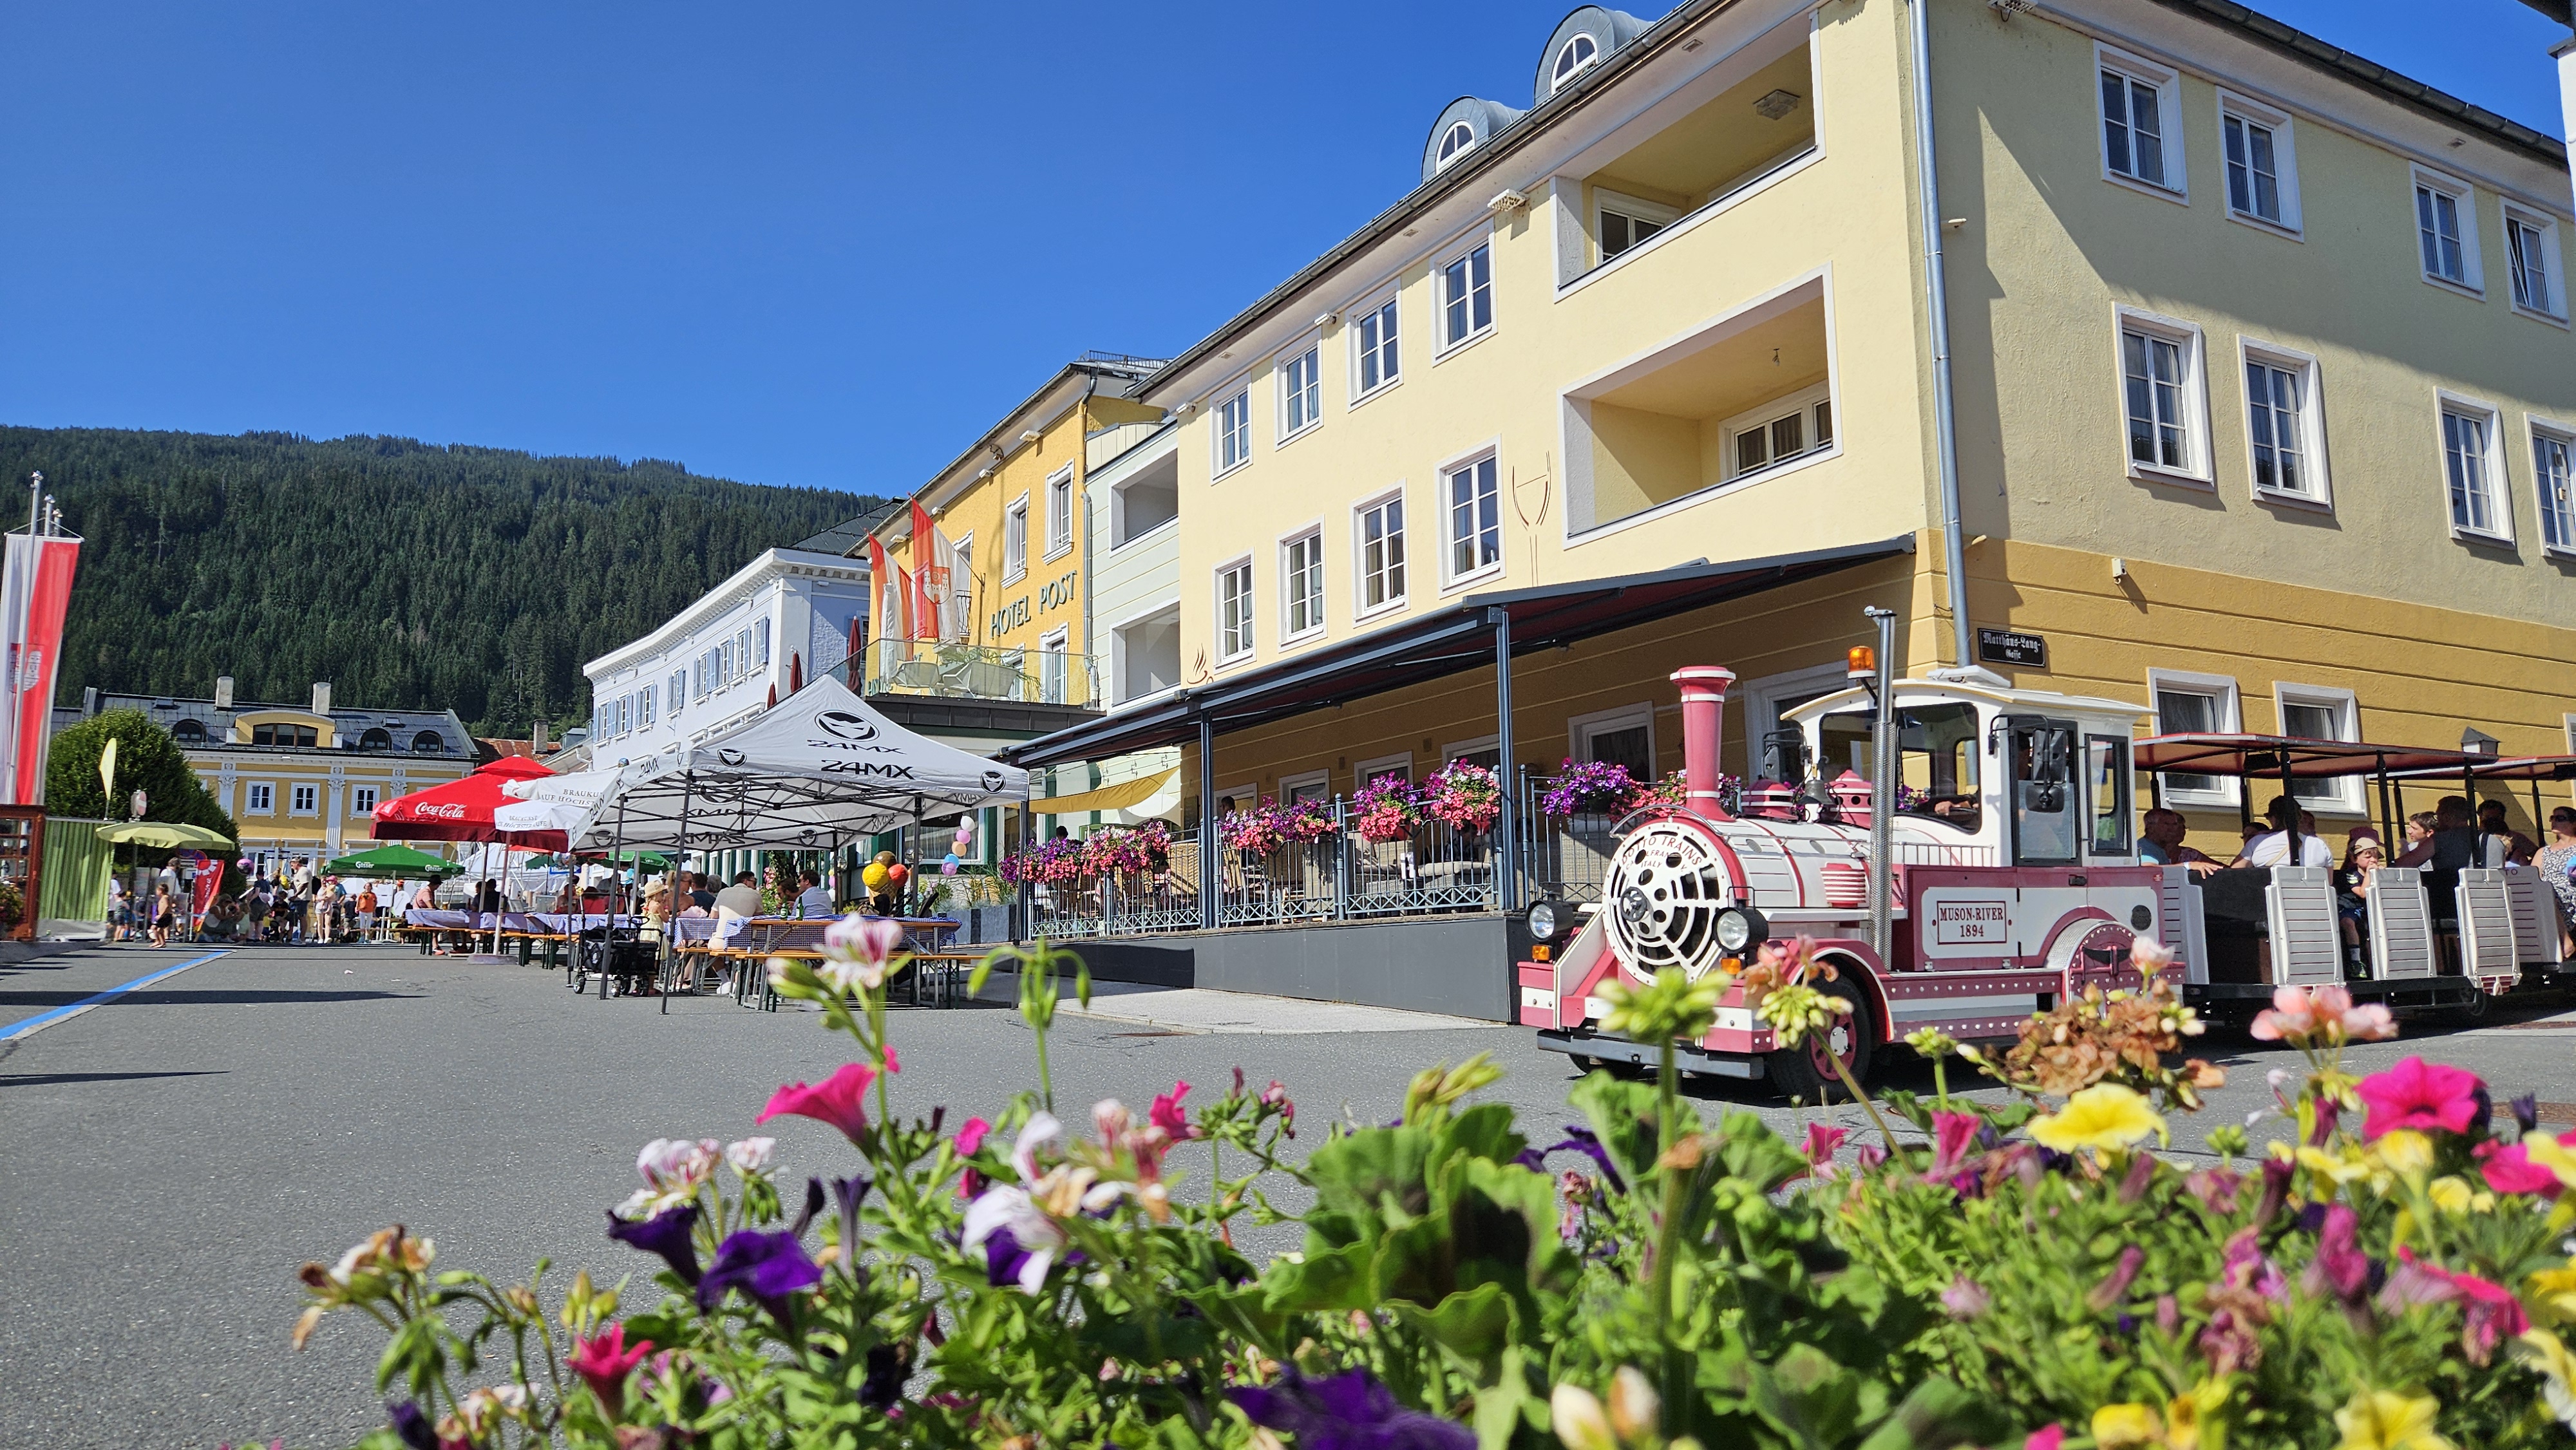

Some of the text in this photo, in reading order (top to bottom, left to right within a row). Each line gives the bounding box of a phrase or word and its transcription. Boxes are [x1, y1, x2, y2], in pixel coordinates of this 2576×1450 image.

[990, 570, 1077, 640] HOTEL POST
[807, 740, 907, 755] 24MX
[821, 760, 915, 780] 24MX
[563, 789, 602, 798] BRAUKU
[415, 802, 467, 818] Coca-Cola
[1622, 836, 1702, 865] DOTTO TRAINS
[1960, 925, 1984, 937] 1894
